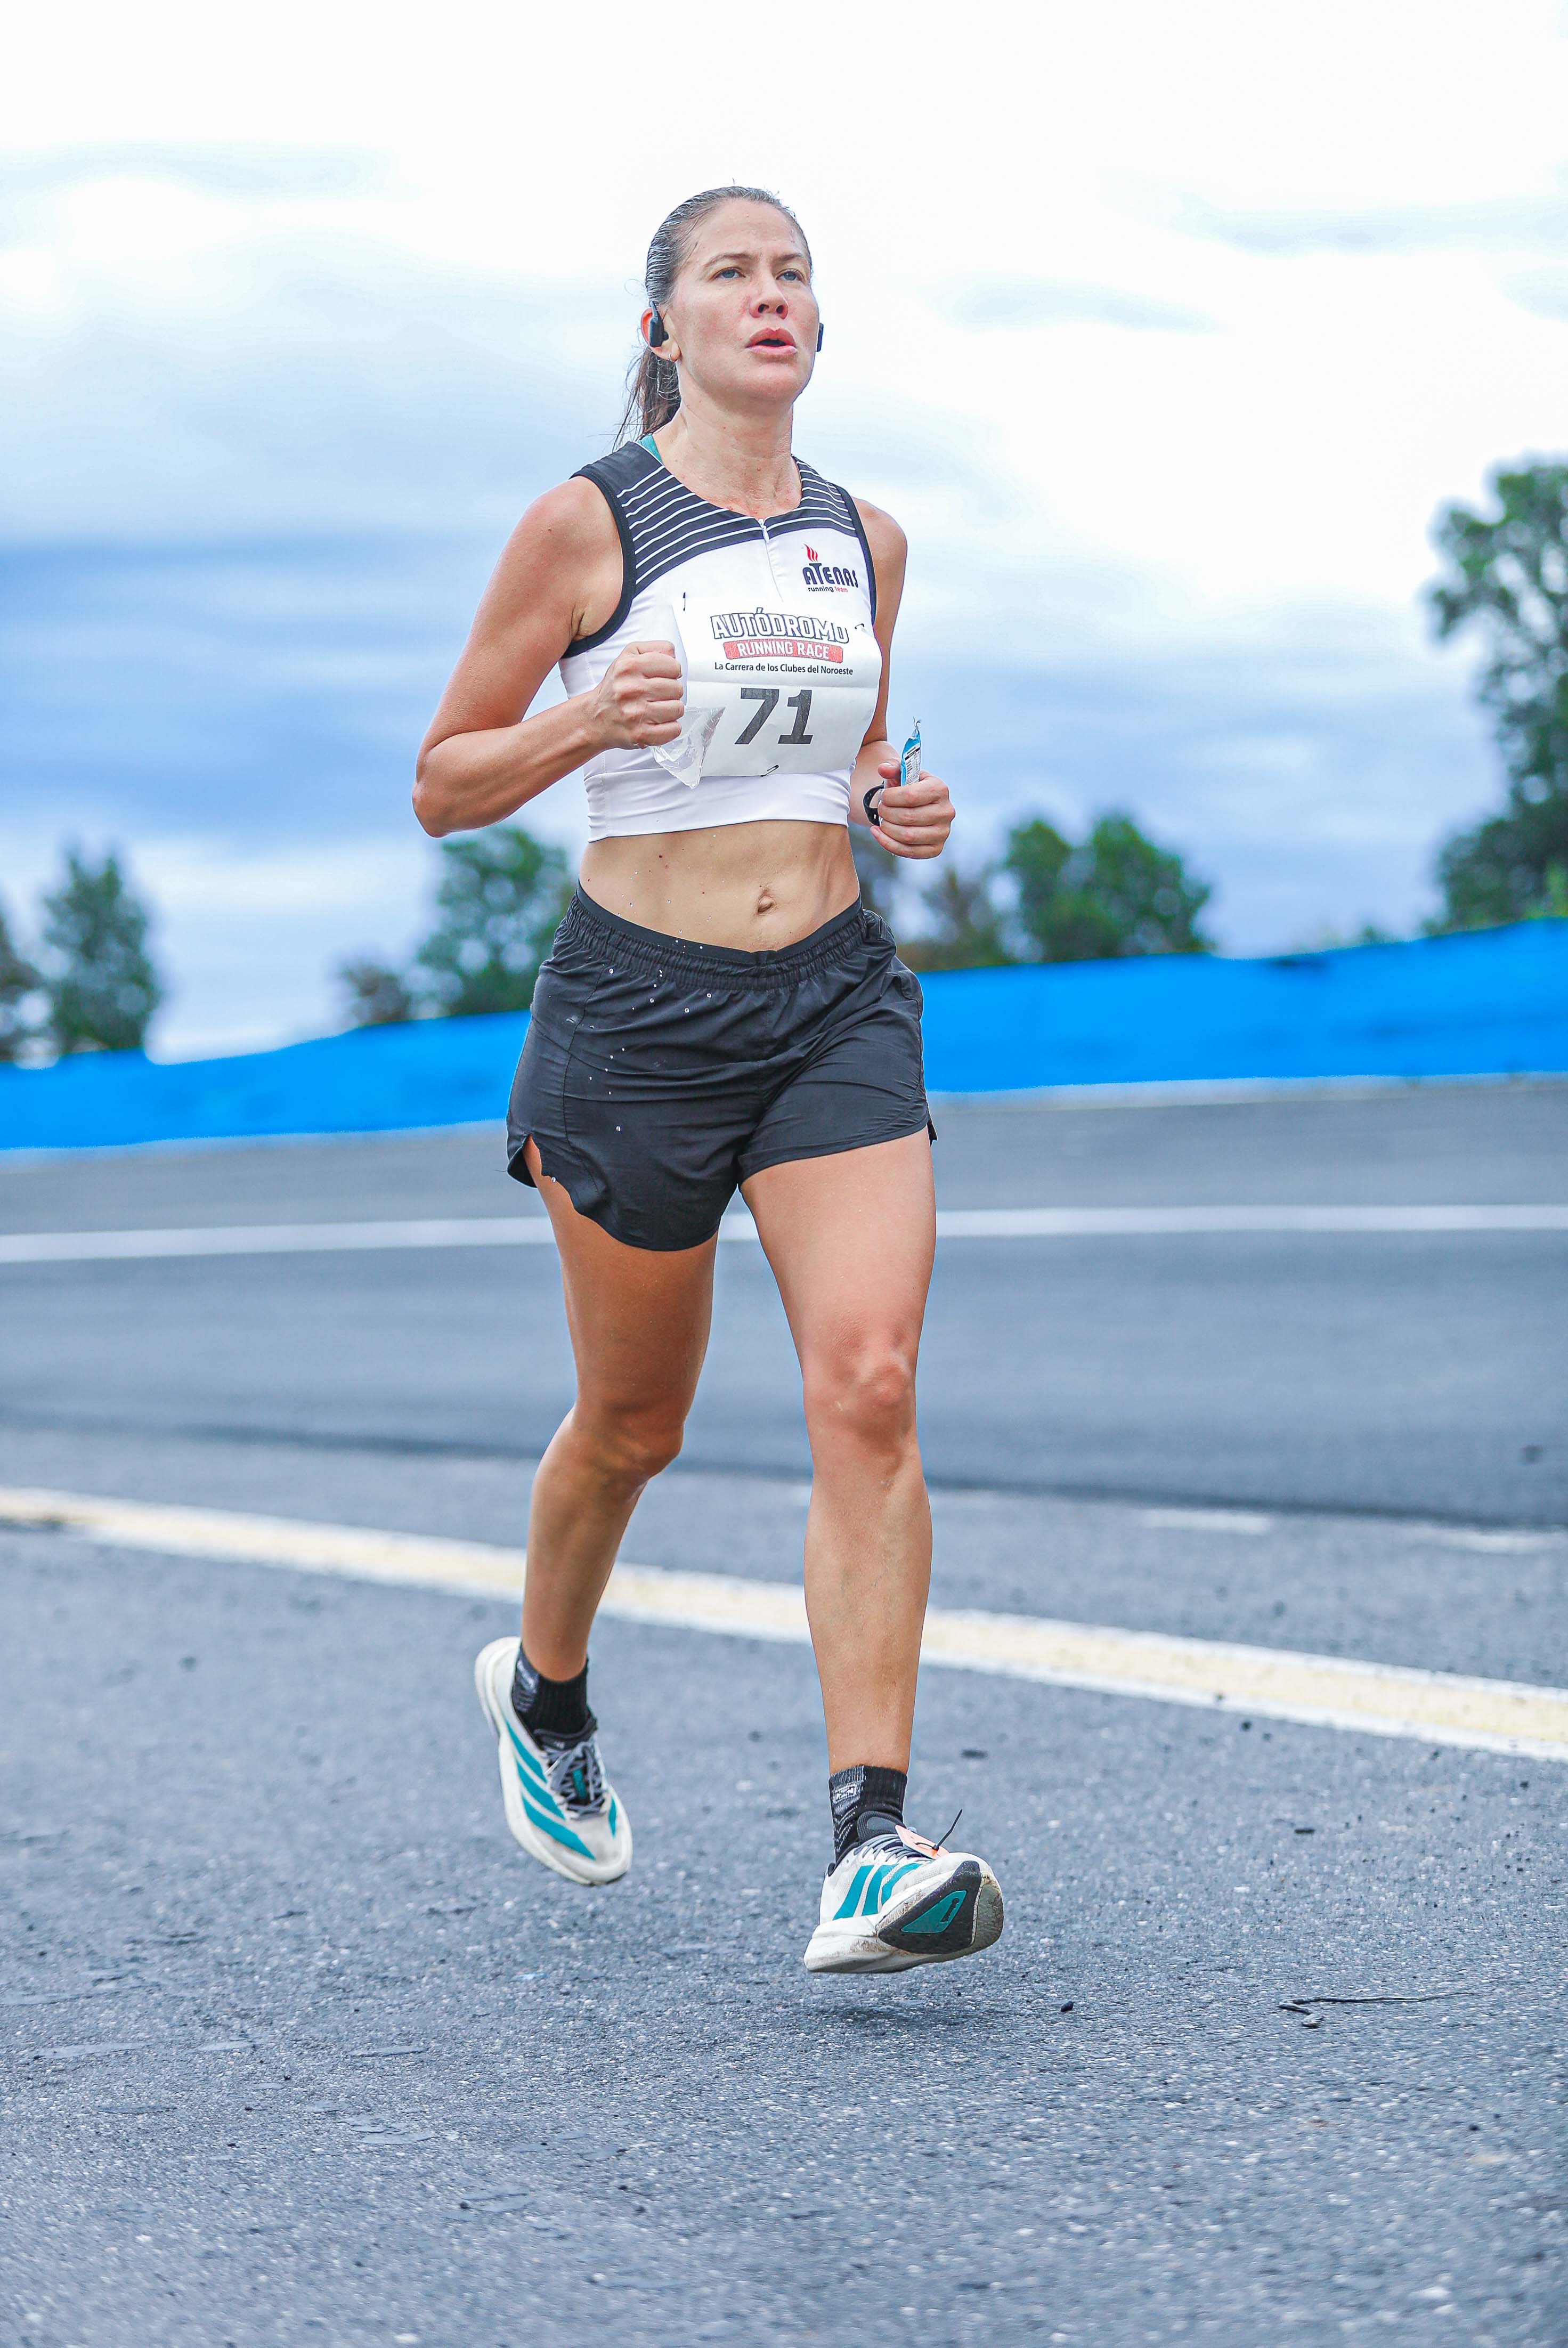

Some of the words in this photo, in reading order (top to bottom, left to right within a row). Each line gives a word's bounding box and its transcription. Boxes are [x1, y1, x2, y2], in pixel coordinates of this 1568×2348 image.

[802, 563, 858, 588] ATENAS
[710, 607, 849, 644] AUTÓDROMO
[737, 641, 793, 657] RUNNING
[797, 641, 830, 659] RACE
[780, 664, 806, 673] Clubes
[807, 664, 819, 673] del
[821, 667, 853, 675] Noroeste
[734, 687, 813, 745] 71
